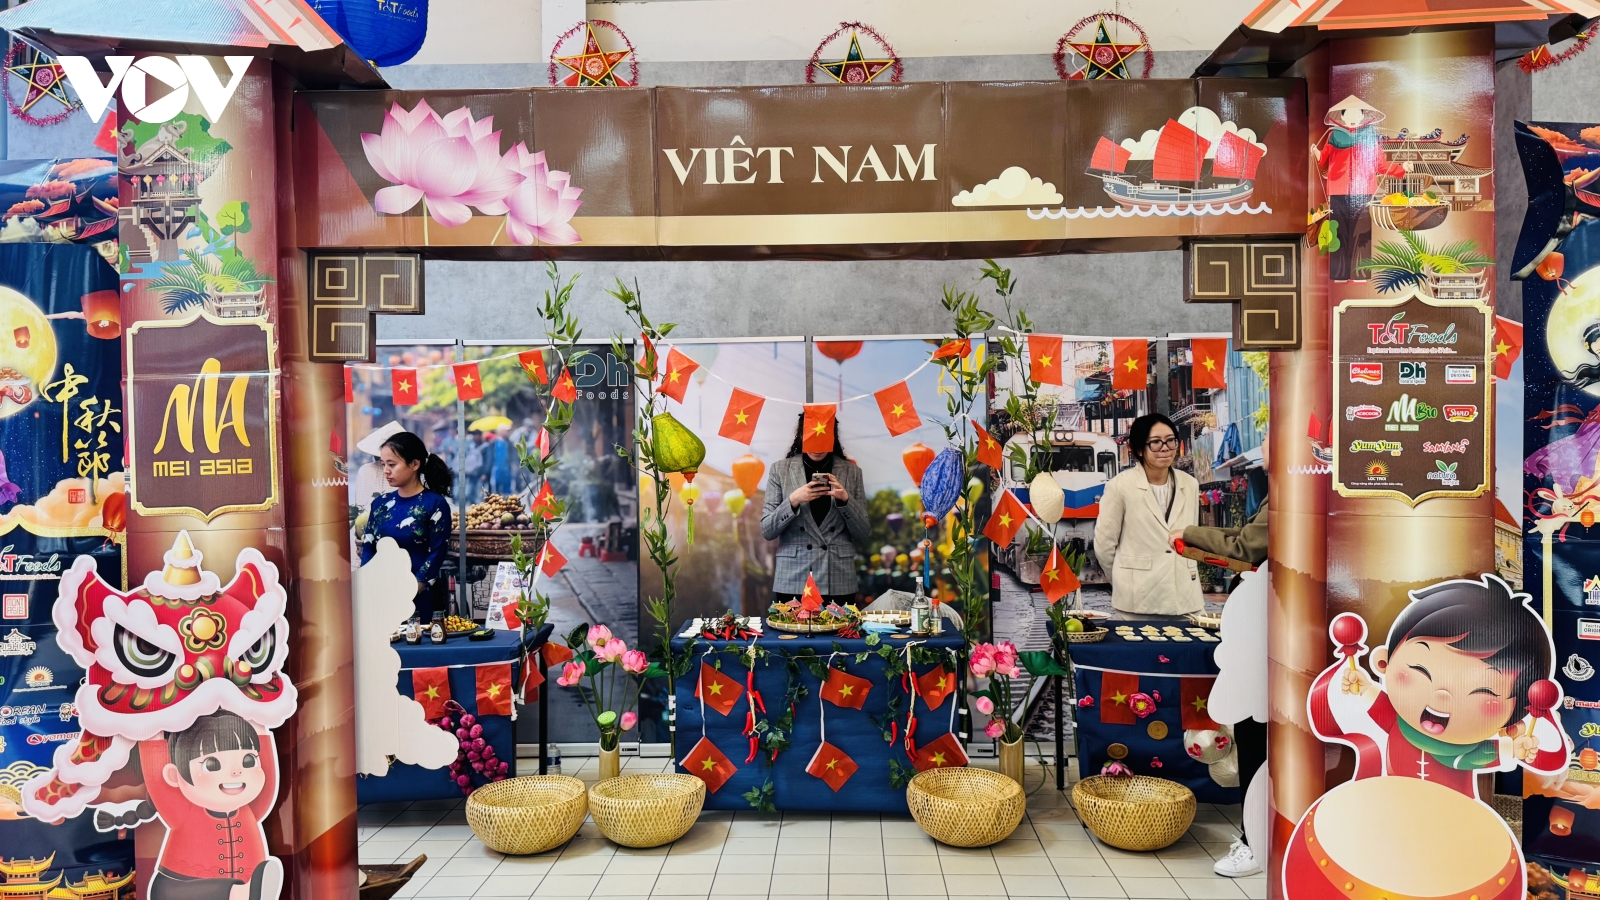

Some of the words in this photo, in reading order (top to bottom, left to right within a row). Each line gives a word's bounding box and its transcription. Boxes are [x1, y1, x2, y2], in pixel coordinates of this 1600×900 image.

[811, 143, 938, 183] NAM
[1367, 318, 1409, 344] T&T
[1407, 323, 1457, 344] Foods
[1400, 362, 1425, 378] Dh
[576, 389, 629, 400] Foods
